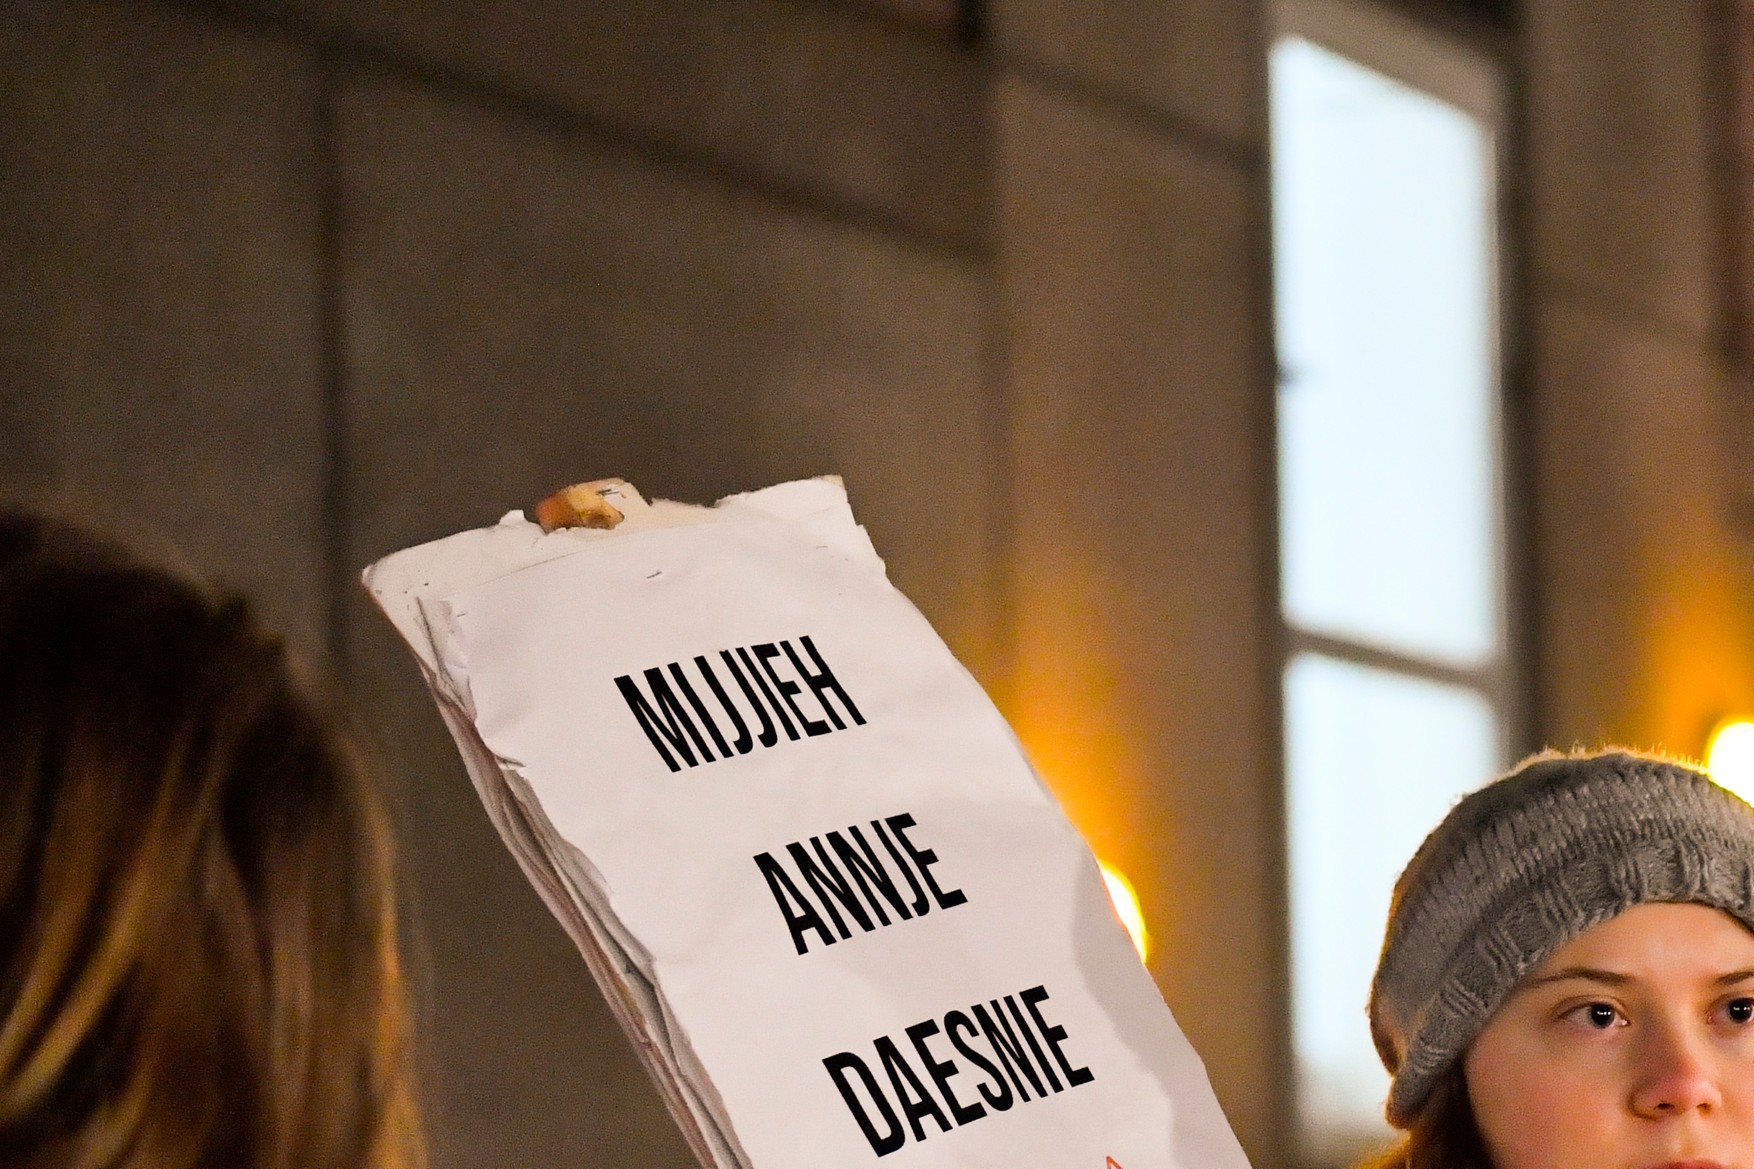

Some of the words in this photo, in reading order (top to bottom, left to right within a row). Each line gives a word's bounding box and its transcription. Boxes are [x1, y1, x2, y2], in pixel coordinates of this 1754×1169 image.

[613, 635, 868, 773] MIJJIEH
[752, 812, 969, 956] ANNJE
[821, 984, 1096, 1158] DAESNIE
